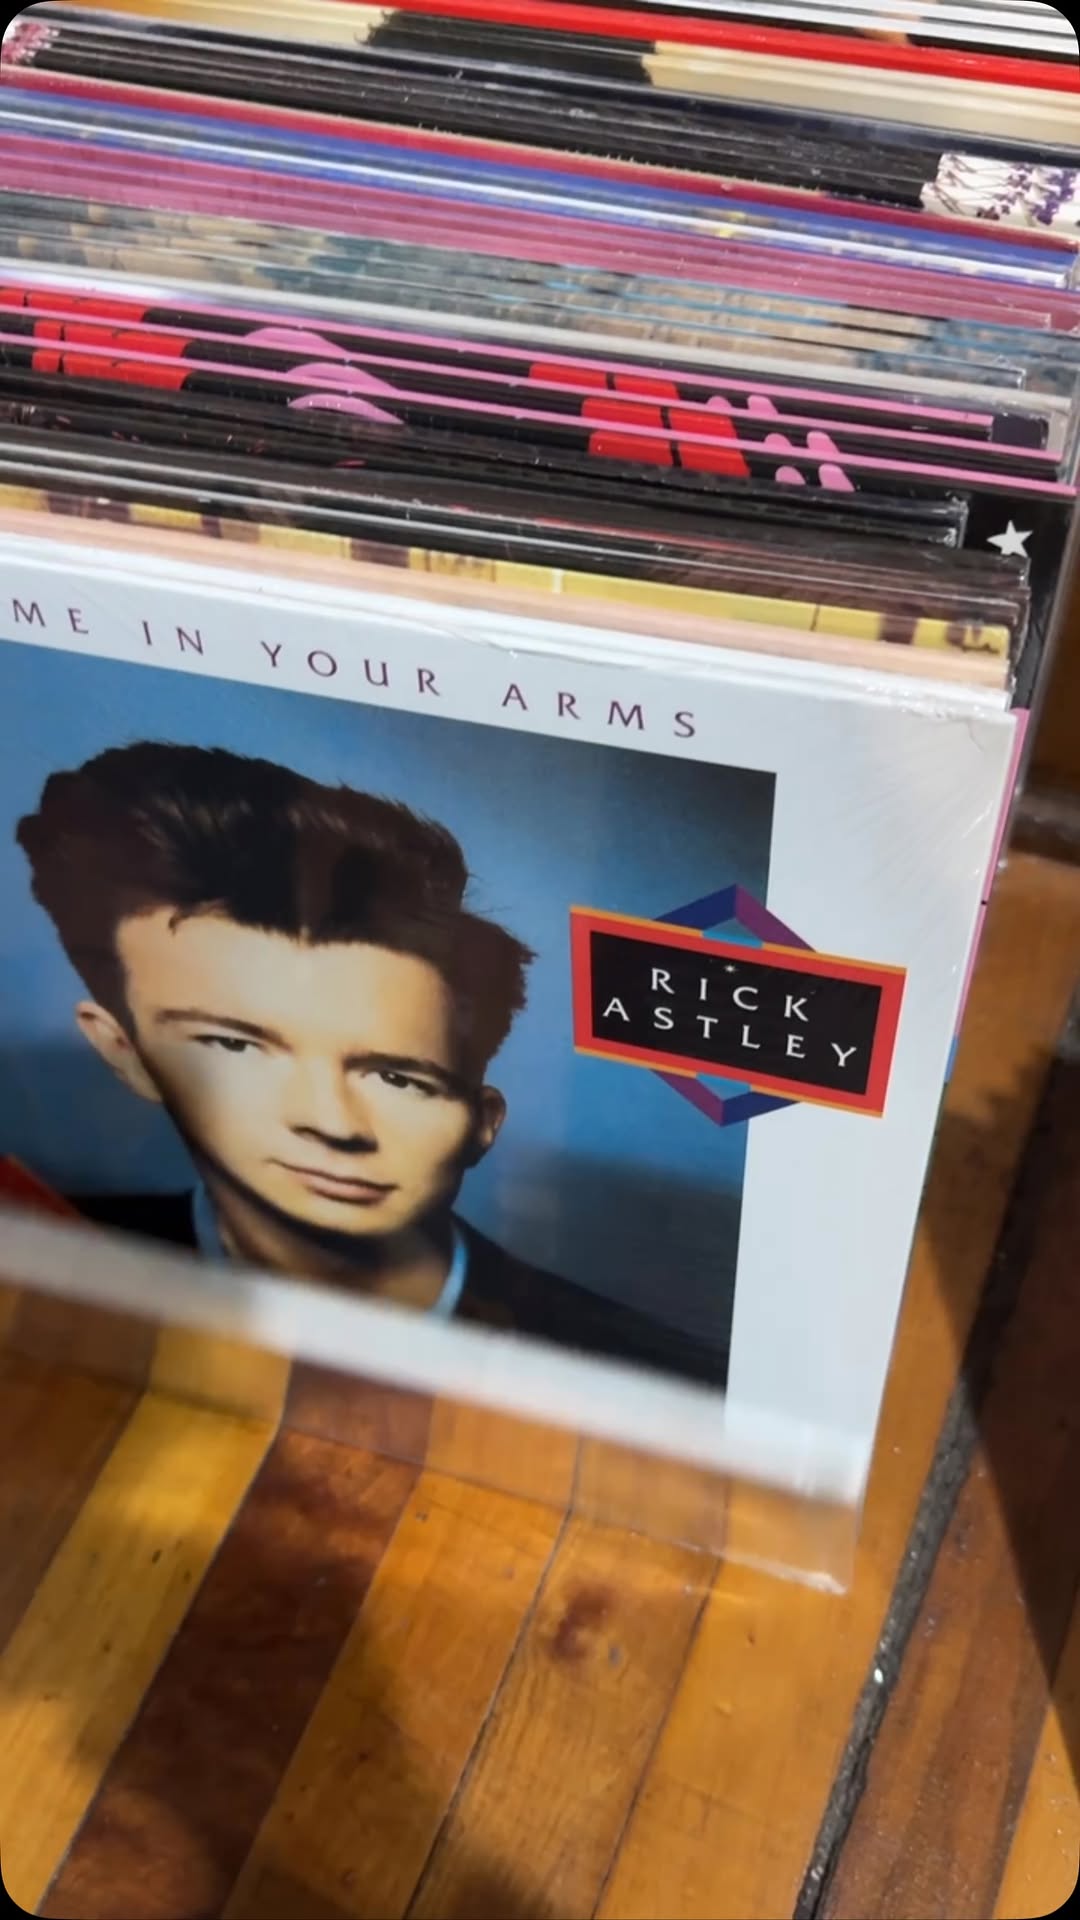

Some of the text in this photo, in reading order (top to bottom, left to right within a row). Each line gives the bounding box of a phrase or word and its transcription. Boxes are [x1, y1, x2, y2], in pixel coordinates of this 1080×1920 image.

[11, 597, 697, 739] ME IN YOUR ARMS
[651, 967, 809, 1022] RICK
[602, 996, 857, 1068] ASTLEY
